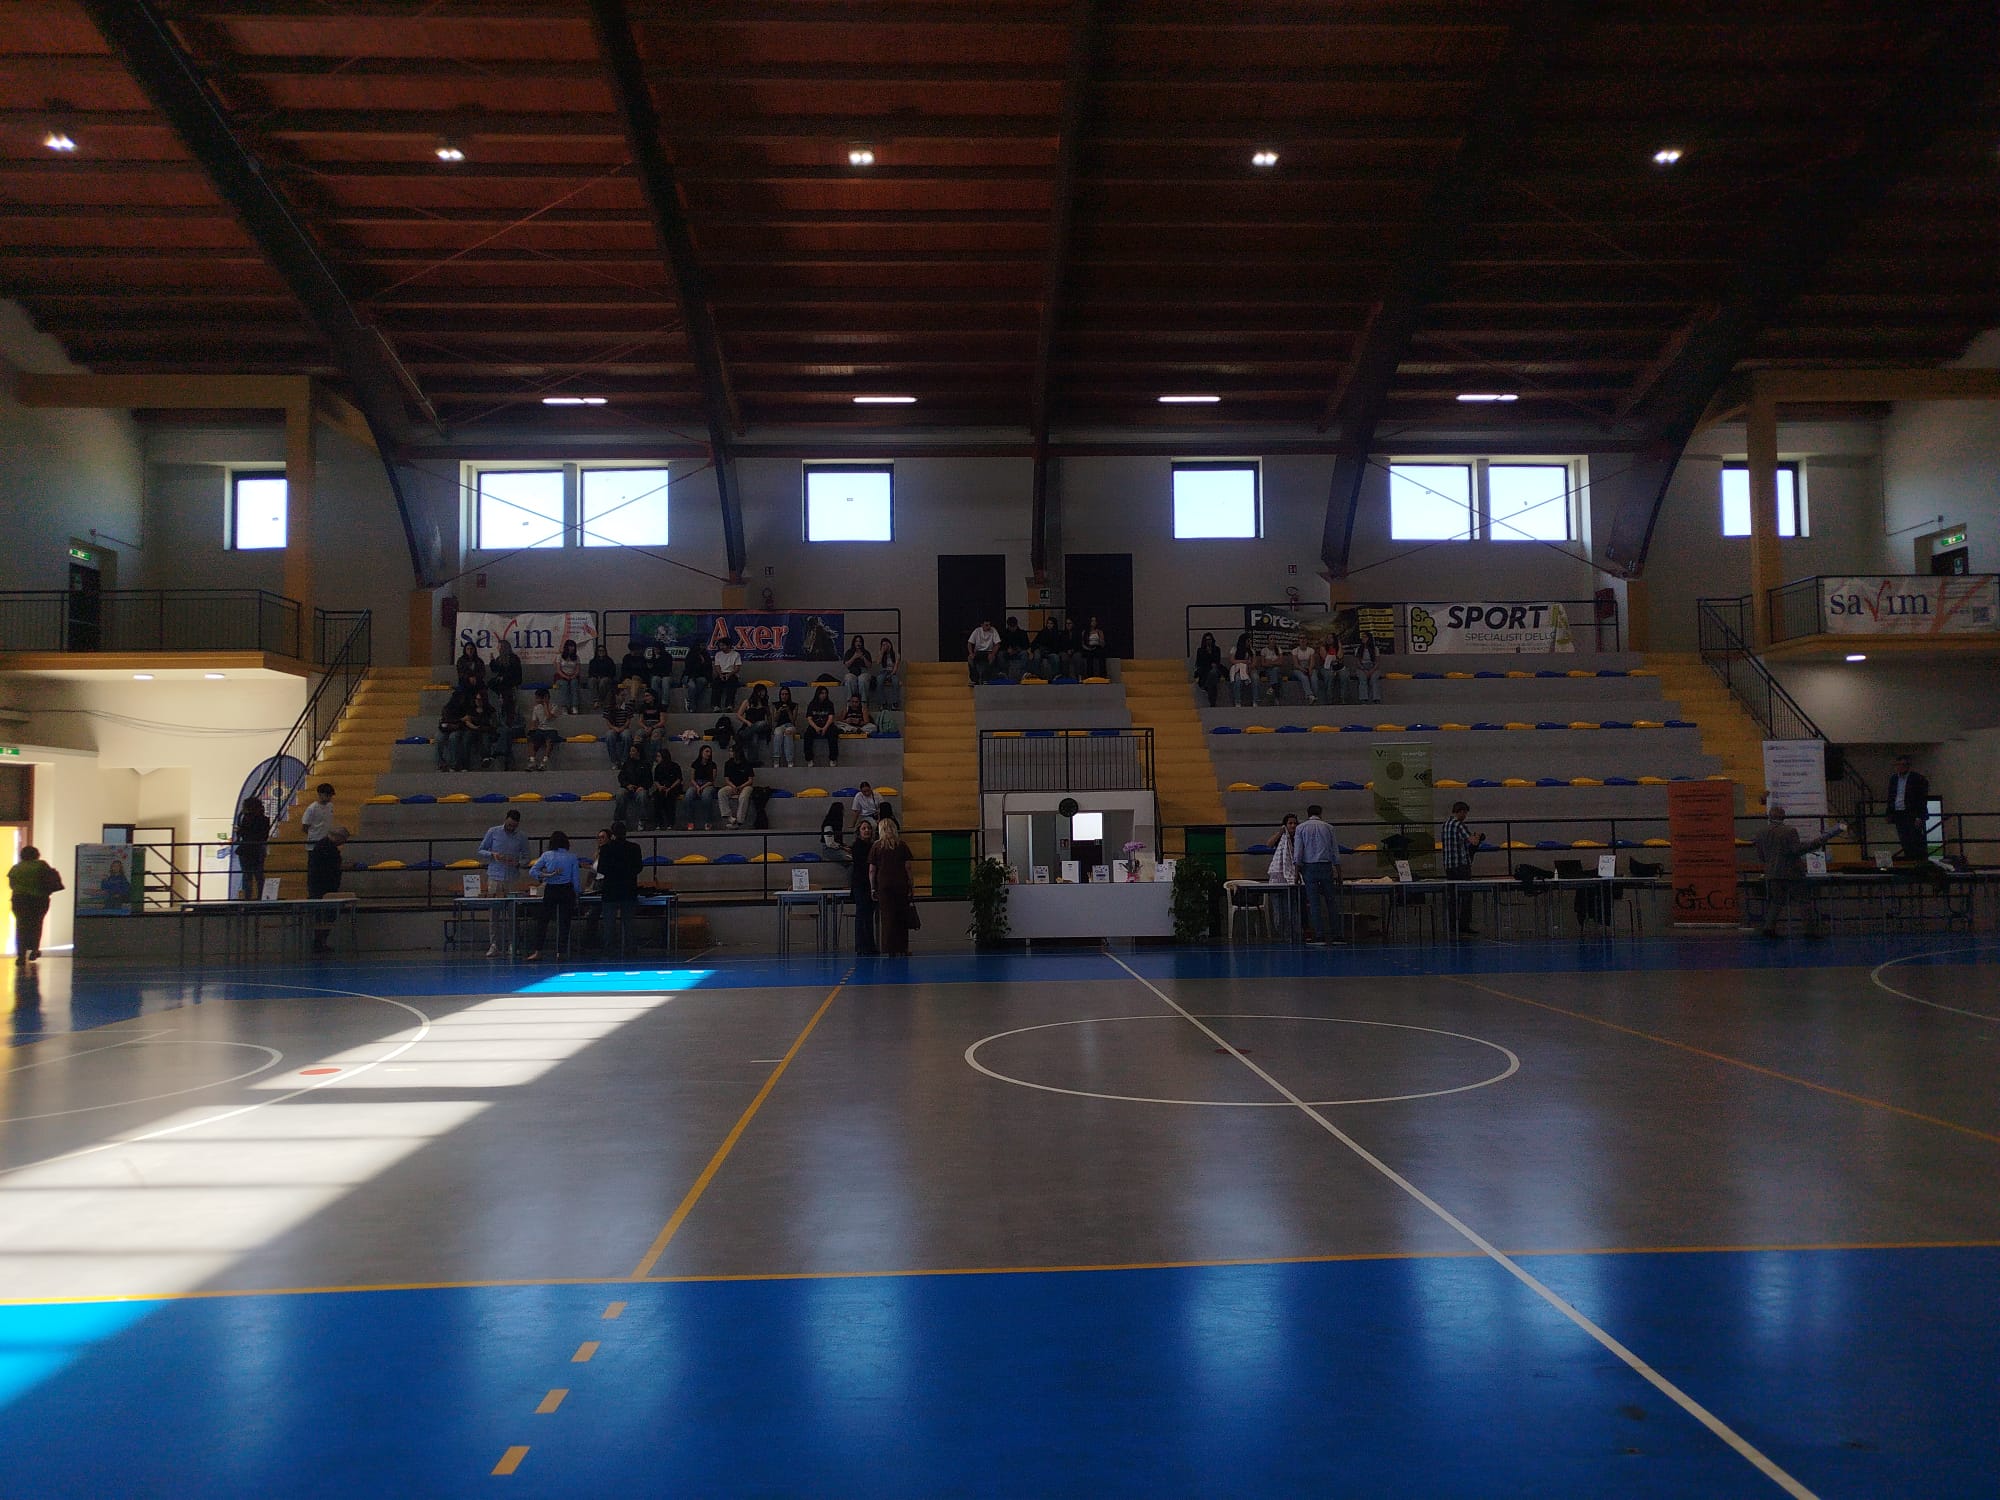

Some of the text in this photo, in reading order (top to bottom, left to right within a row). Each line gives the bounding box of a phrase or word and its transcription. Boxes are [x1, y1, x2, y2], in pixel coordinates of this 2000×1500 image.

[1830, 581, 1931, 622] savim
[1251, 610, 1300, 628] Forex
[1447, 605, 1549, 629] SPORT
[707, 616, 789, 650] Axer
[1465, 632, 1522, 641] SPECIALISTI
